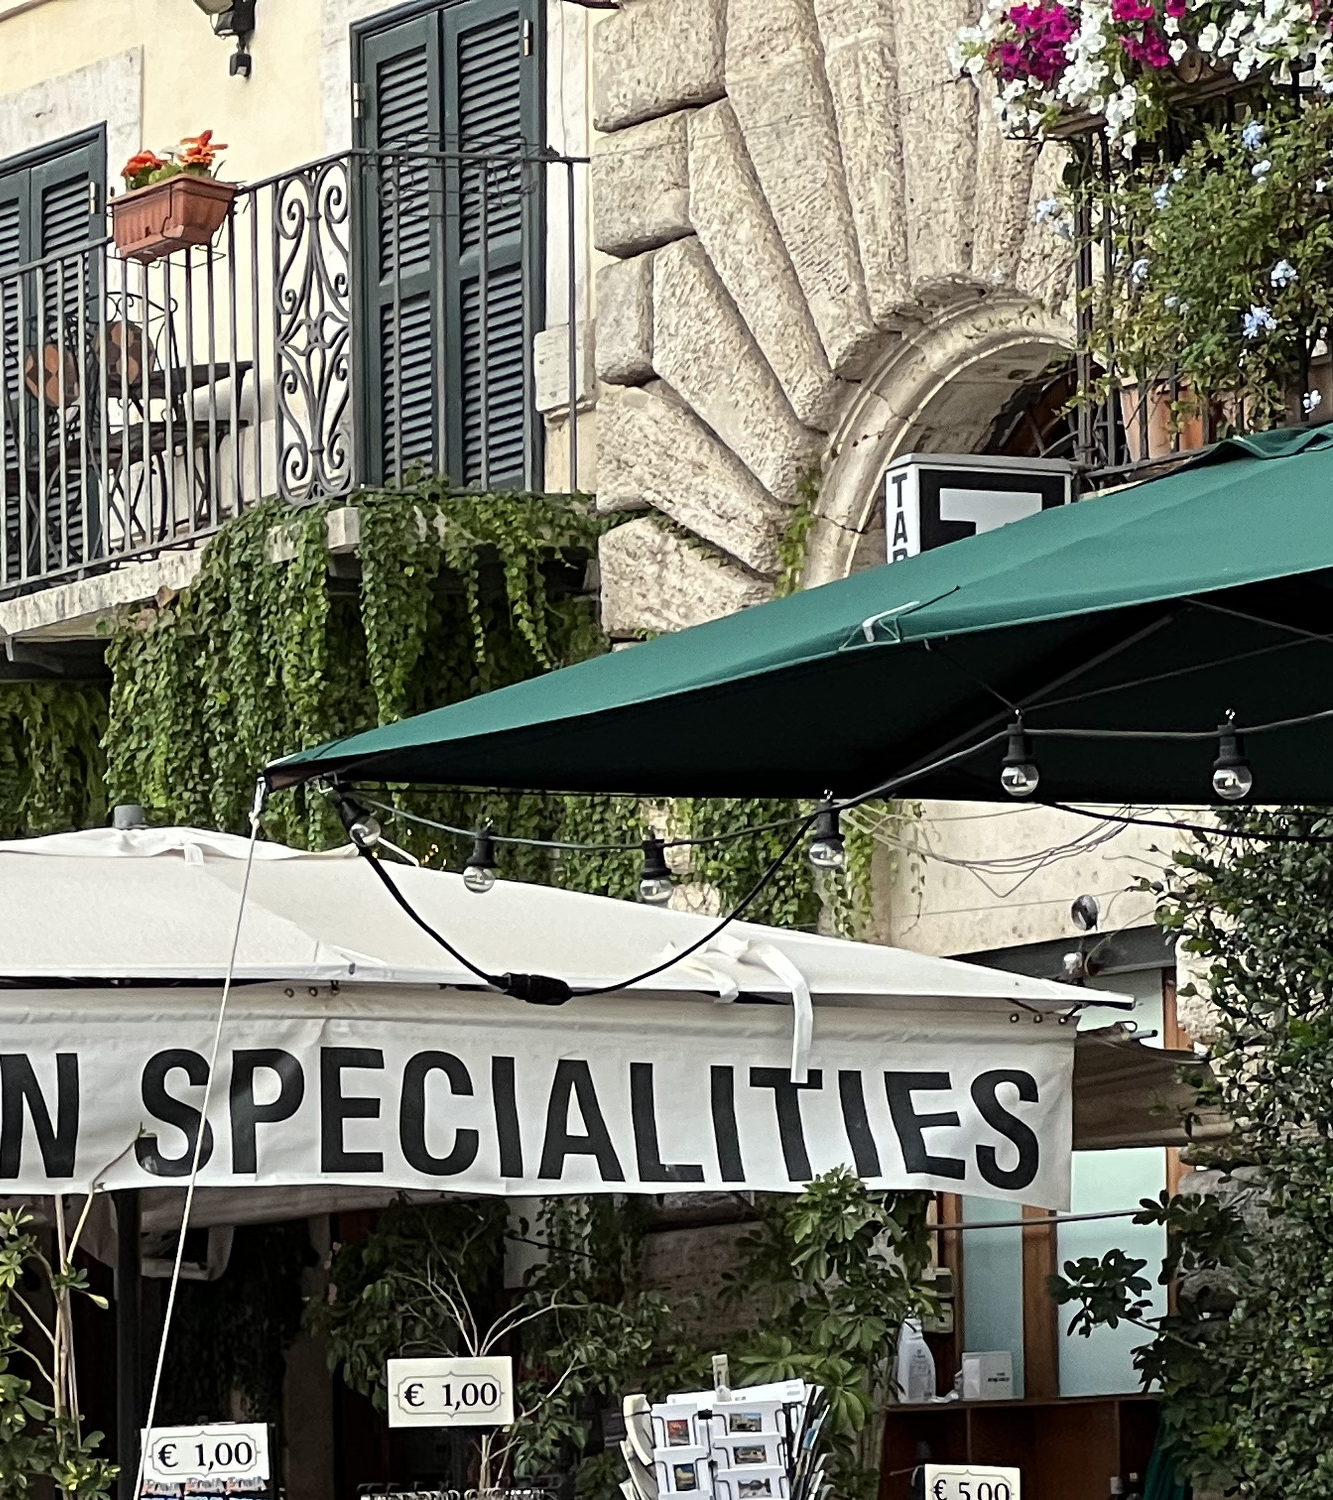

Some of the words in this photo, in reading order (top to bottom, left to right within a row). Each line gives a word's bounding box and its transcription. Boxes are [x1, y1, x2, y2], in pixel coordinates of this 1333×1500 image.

[136, 1046, 1041, 1192] SPECIALITIES
[404, 1383, 425, 1407] €
[441, 1382, 498, 1411] 1,00
[157, 1443, 179, 1468] €
[194, 1441, 253, 1472] 1,00
